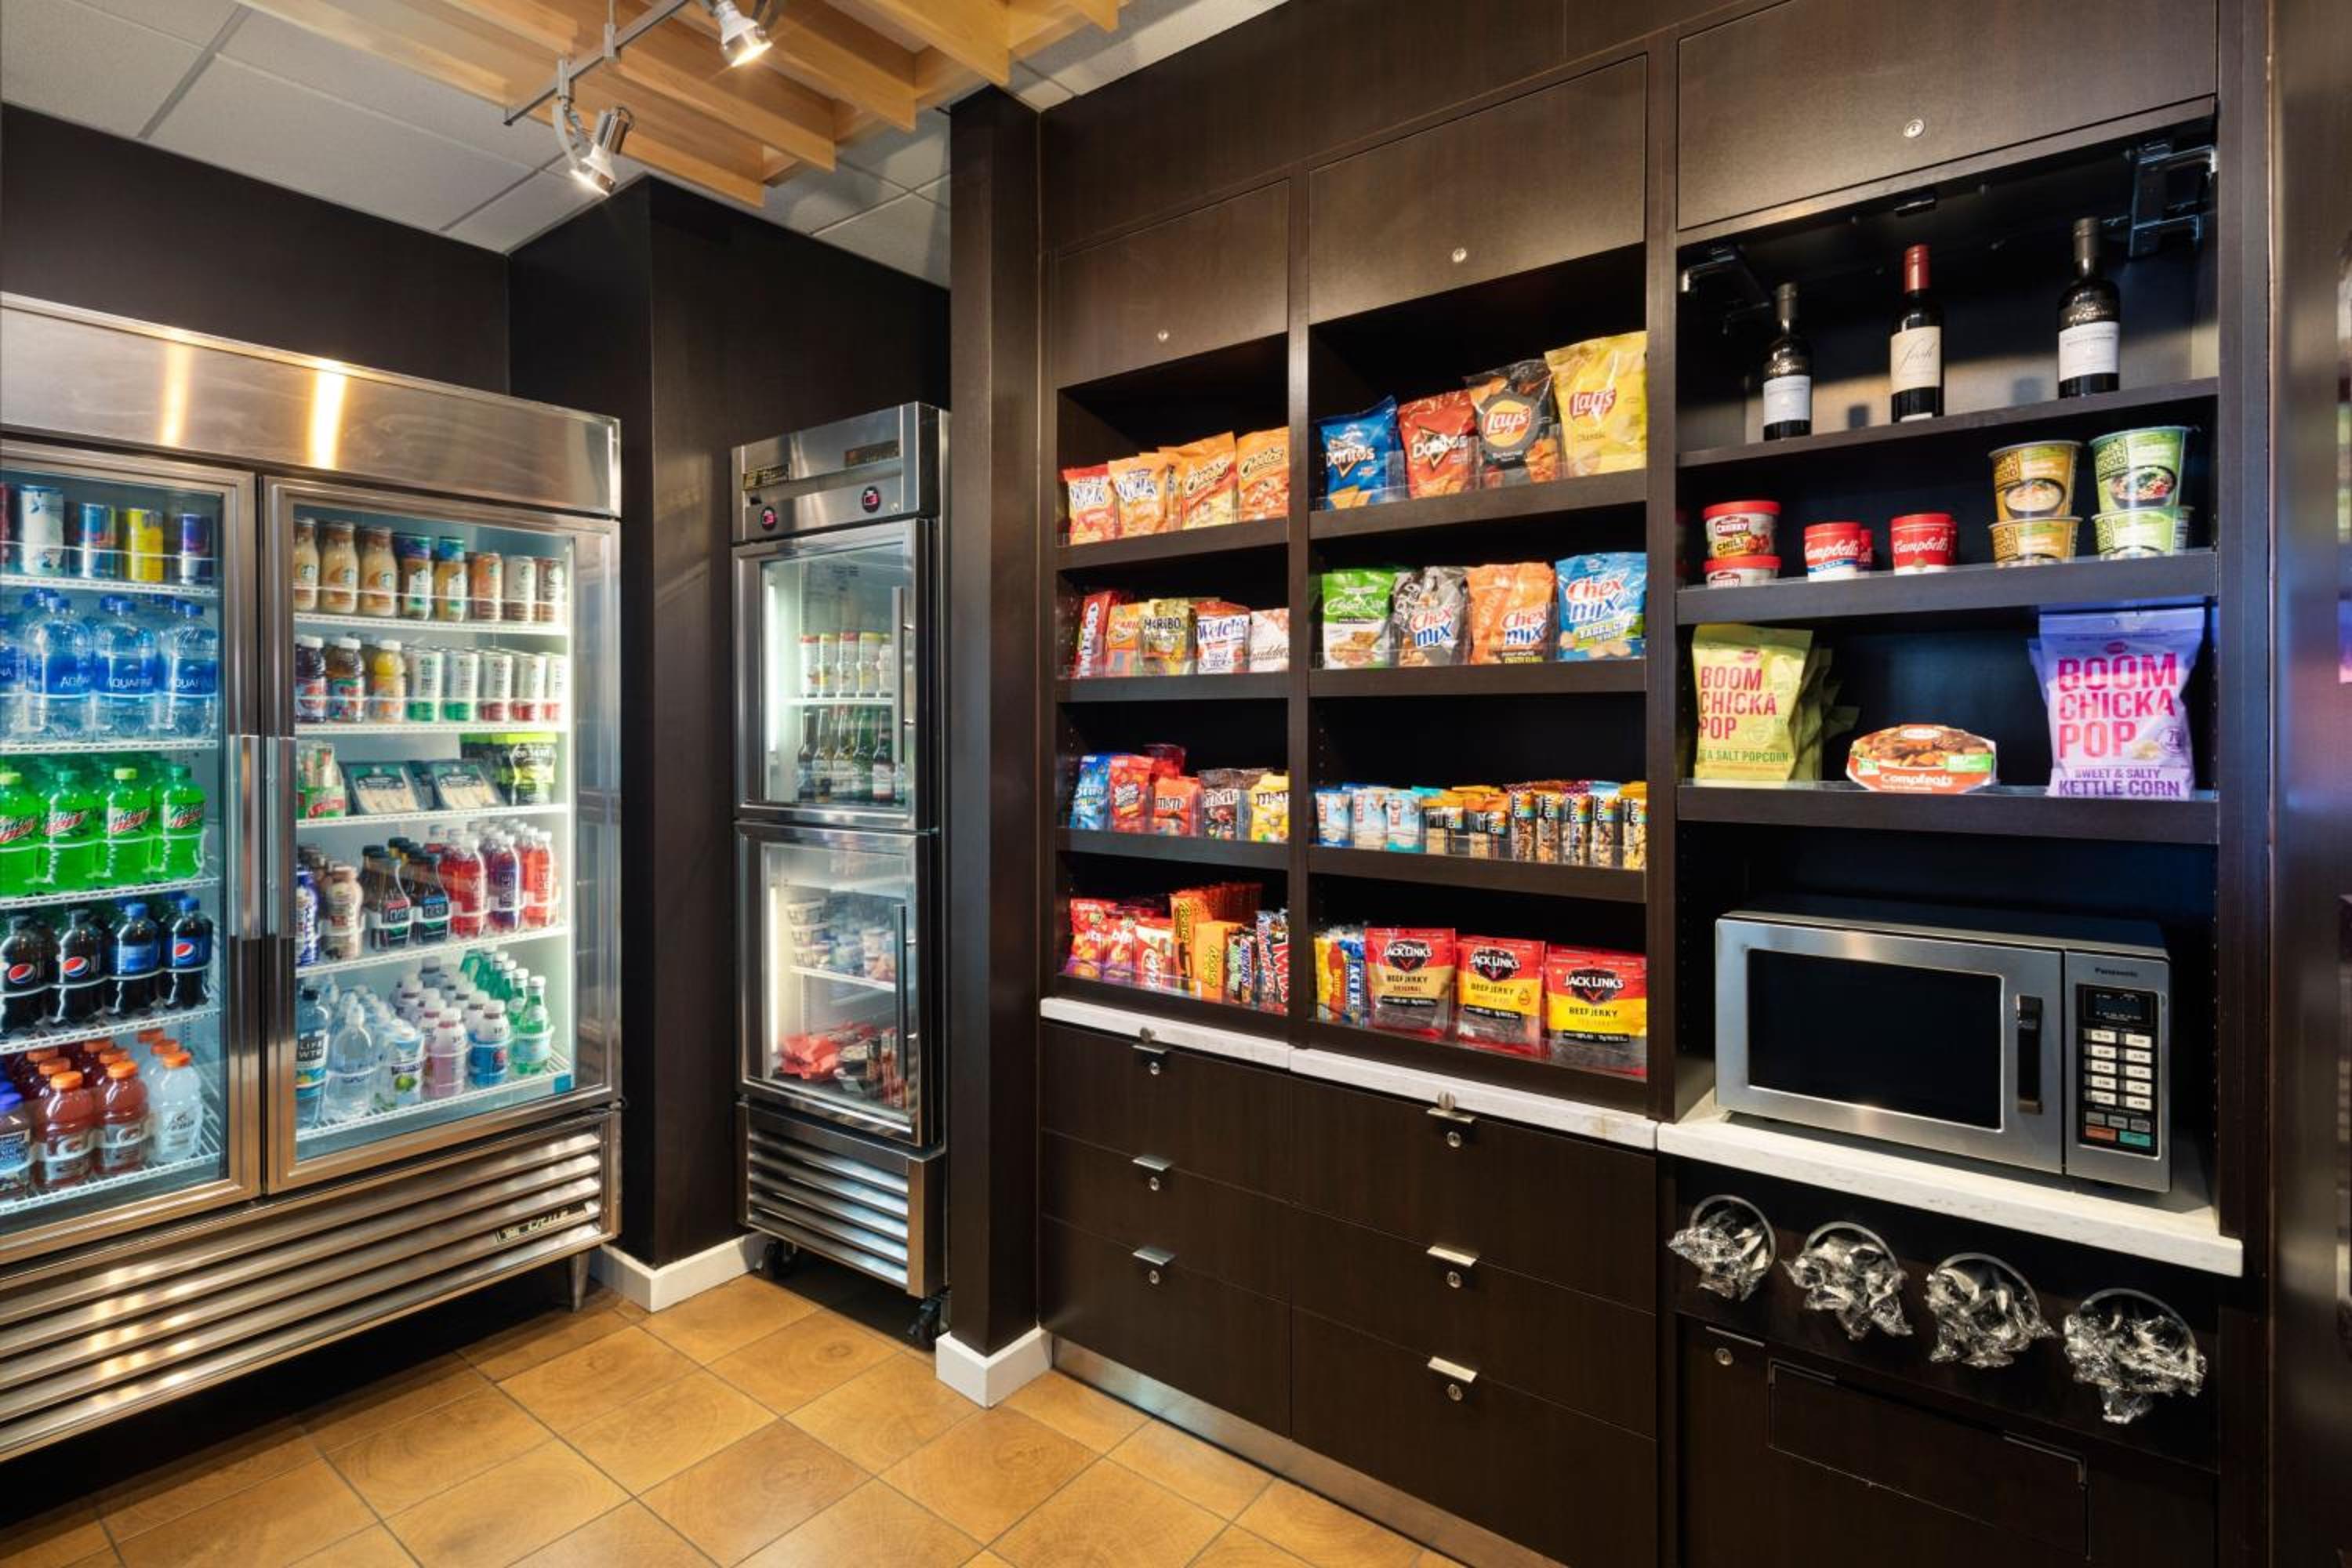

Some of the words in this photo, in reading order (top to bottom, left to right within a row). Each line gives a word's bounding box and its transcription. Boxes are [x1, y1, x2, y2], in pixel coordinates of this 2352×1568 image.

[1327, 445, 1376, 467] Doritos
[1567, 576, 1622, 601] Chex
[1144, 616, 1181, 630] HARIBO
[1411, 607, 1453, 632] Chex
[1501, 610, 1546, 629] Chex
[1700, 666, 1762, 691] BOOM
[2058, 652, 2177, 692] BOOM
[1700, 691, 1777, 716] CHICKA
[2058, 688, 2176, 720] CHICKA
[1700, 717, 1737, 739] POP
[2058, 720, 2136, 759] POP
[1715, 750, 1739, 760] SALT
[1740, 751, 1788, 763] POPCORN
[2074, 768, 2111, 779] SWEET
[2125, 768, 2161, 779] SALTY
[2058, 780, 2123, 796] KETTLE
[2128, 780, 2180, 797] CORN
[1471, 983, 1489, 992] BEEF
[1490, 985, 1514, 995] JERKY
[1569, 1007, 1588, 1015] BEEF
[1591, 1007, 1617, 1018] JERKY
